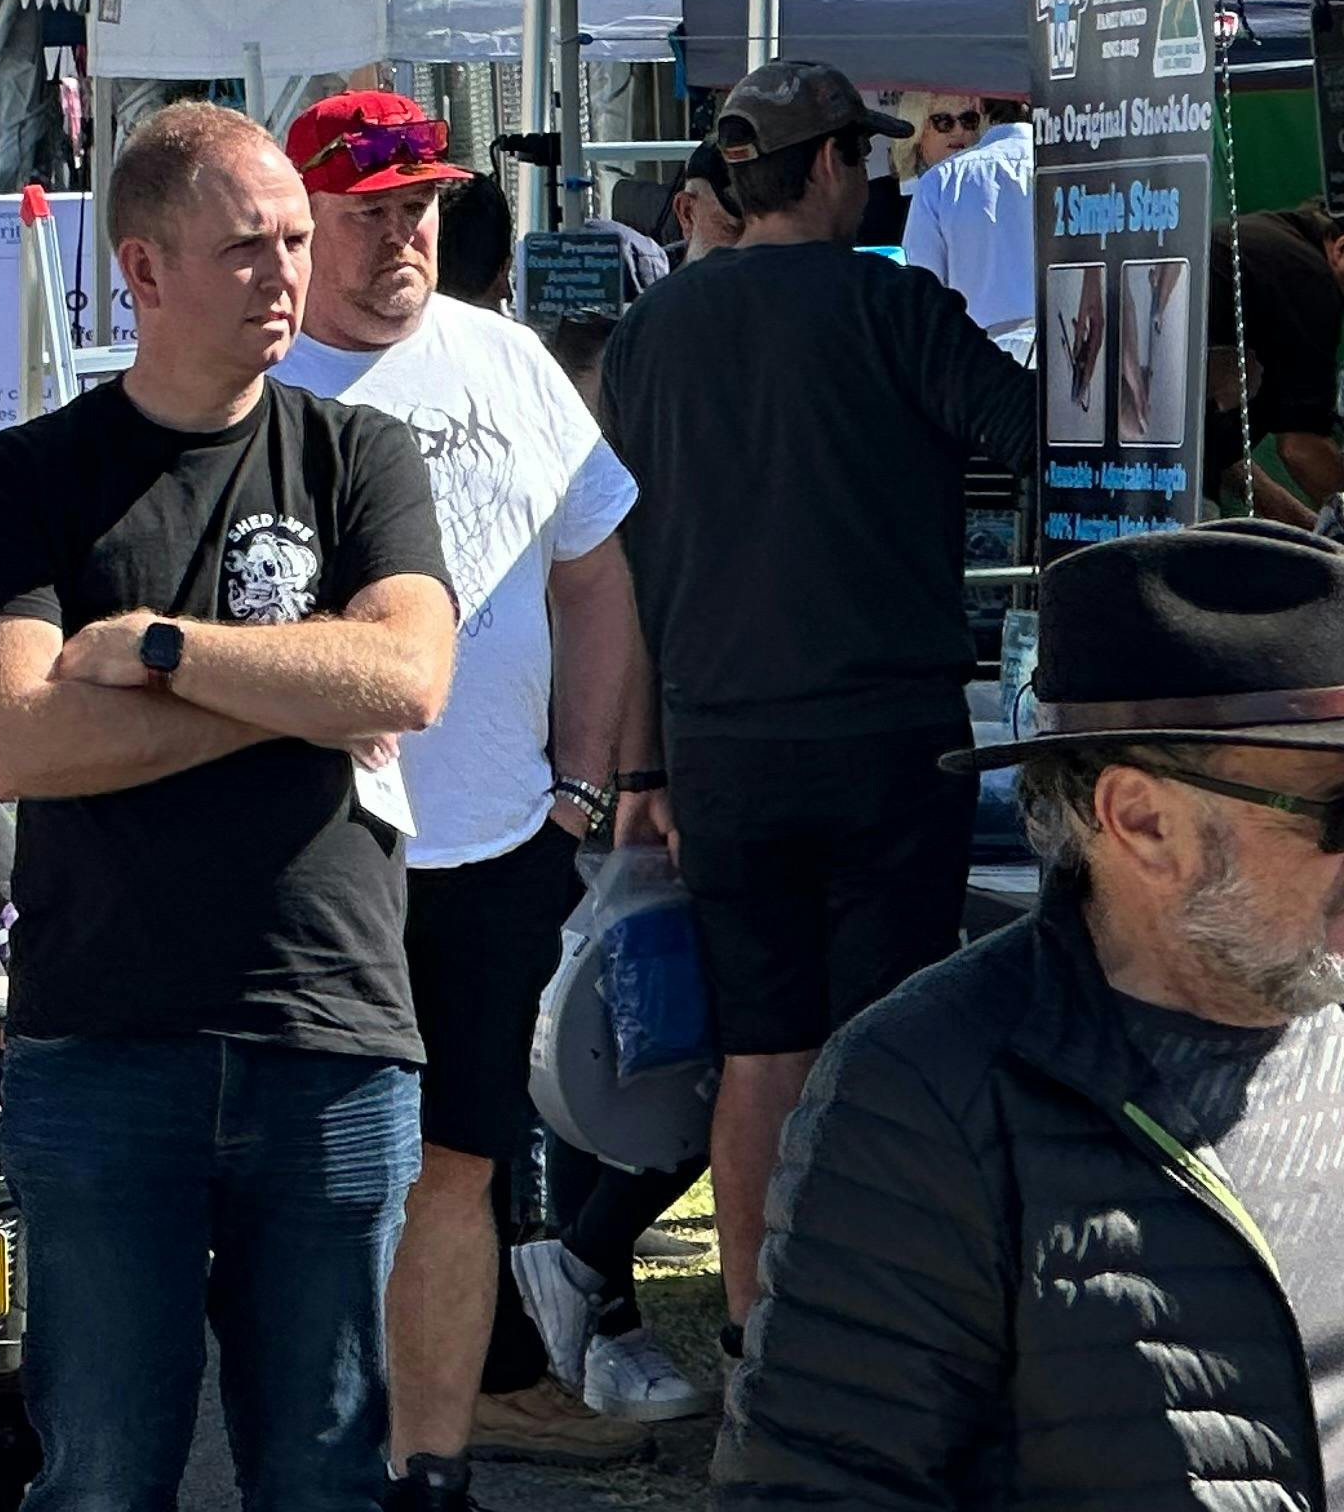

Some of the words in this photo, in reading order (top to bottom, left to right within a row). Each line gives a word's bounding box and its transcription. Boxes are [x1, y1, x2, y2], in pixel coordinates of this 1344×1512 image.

[1032, 107, 1061, 146] The
[1064, 99, 1127, 150] Original
[1130, 93, 1212, 136] Shockloc
[1053, 186, 1065, 237] 2
[1067, 182, 1126, 250] Simple
[1128, 179, 1180, 247] Steps
[228, 513, 274, 543] SHED
[277, 514, 315, 542] LIFE
